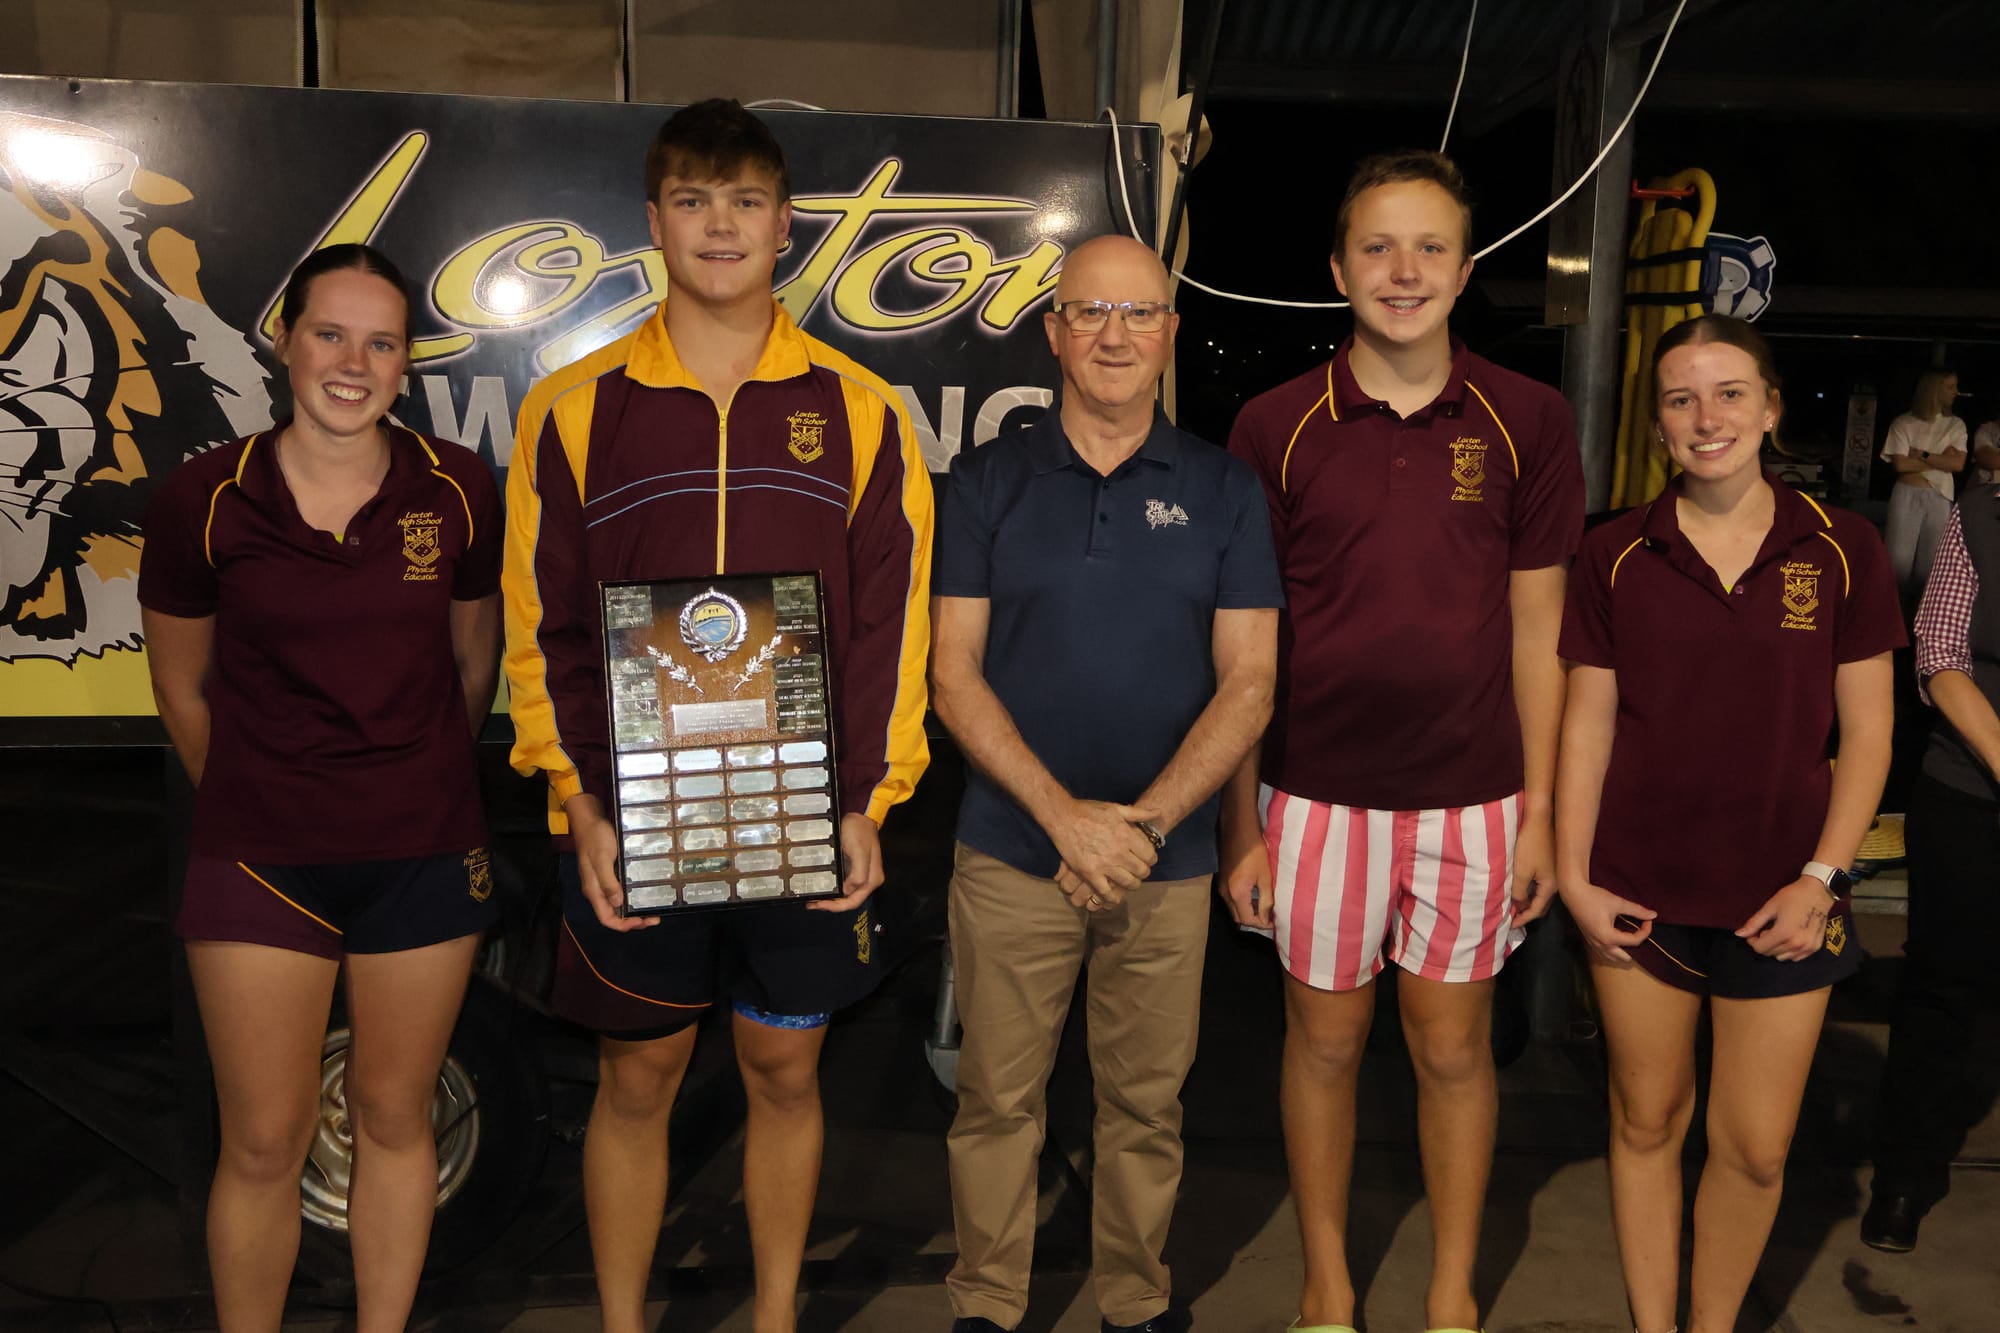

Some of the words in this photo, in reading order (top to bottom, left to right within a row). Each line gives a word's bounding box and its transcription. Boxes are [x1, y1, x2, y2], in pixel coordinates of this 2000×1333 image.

[795, 410, 820, 418] Loxton
[802, 417, 828, 425] School
[1456, 436, 1481, 444] Loxton
[1449, 442, 1465, 451] High
[1464, 443, 1488, 451] School
[406, 511, 433, 519] Loxton
[397, 518, 416, 528] High
[415, 516, 443, 526] School
[1786, 561, 1813, 569] Loxton
[1780, 566, 1796, 576] High
[1795, 568, 1822, 576] School
